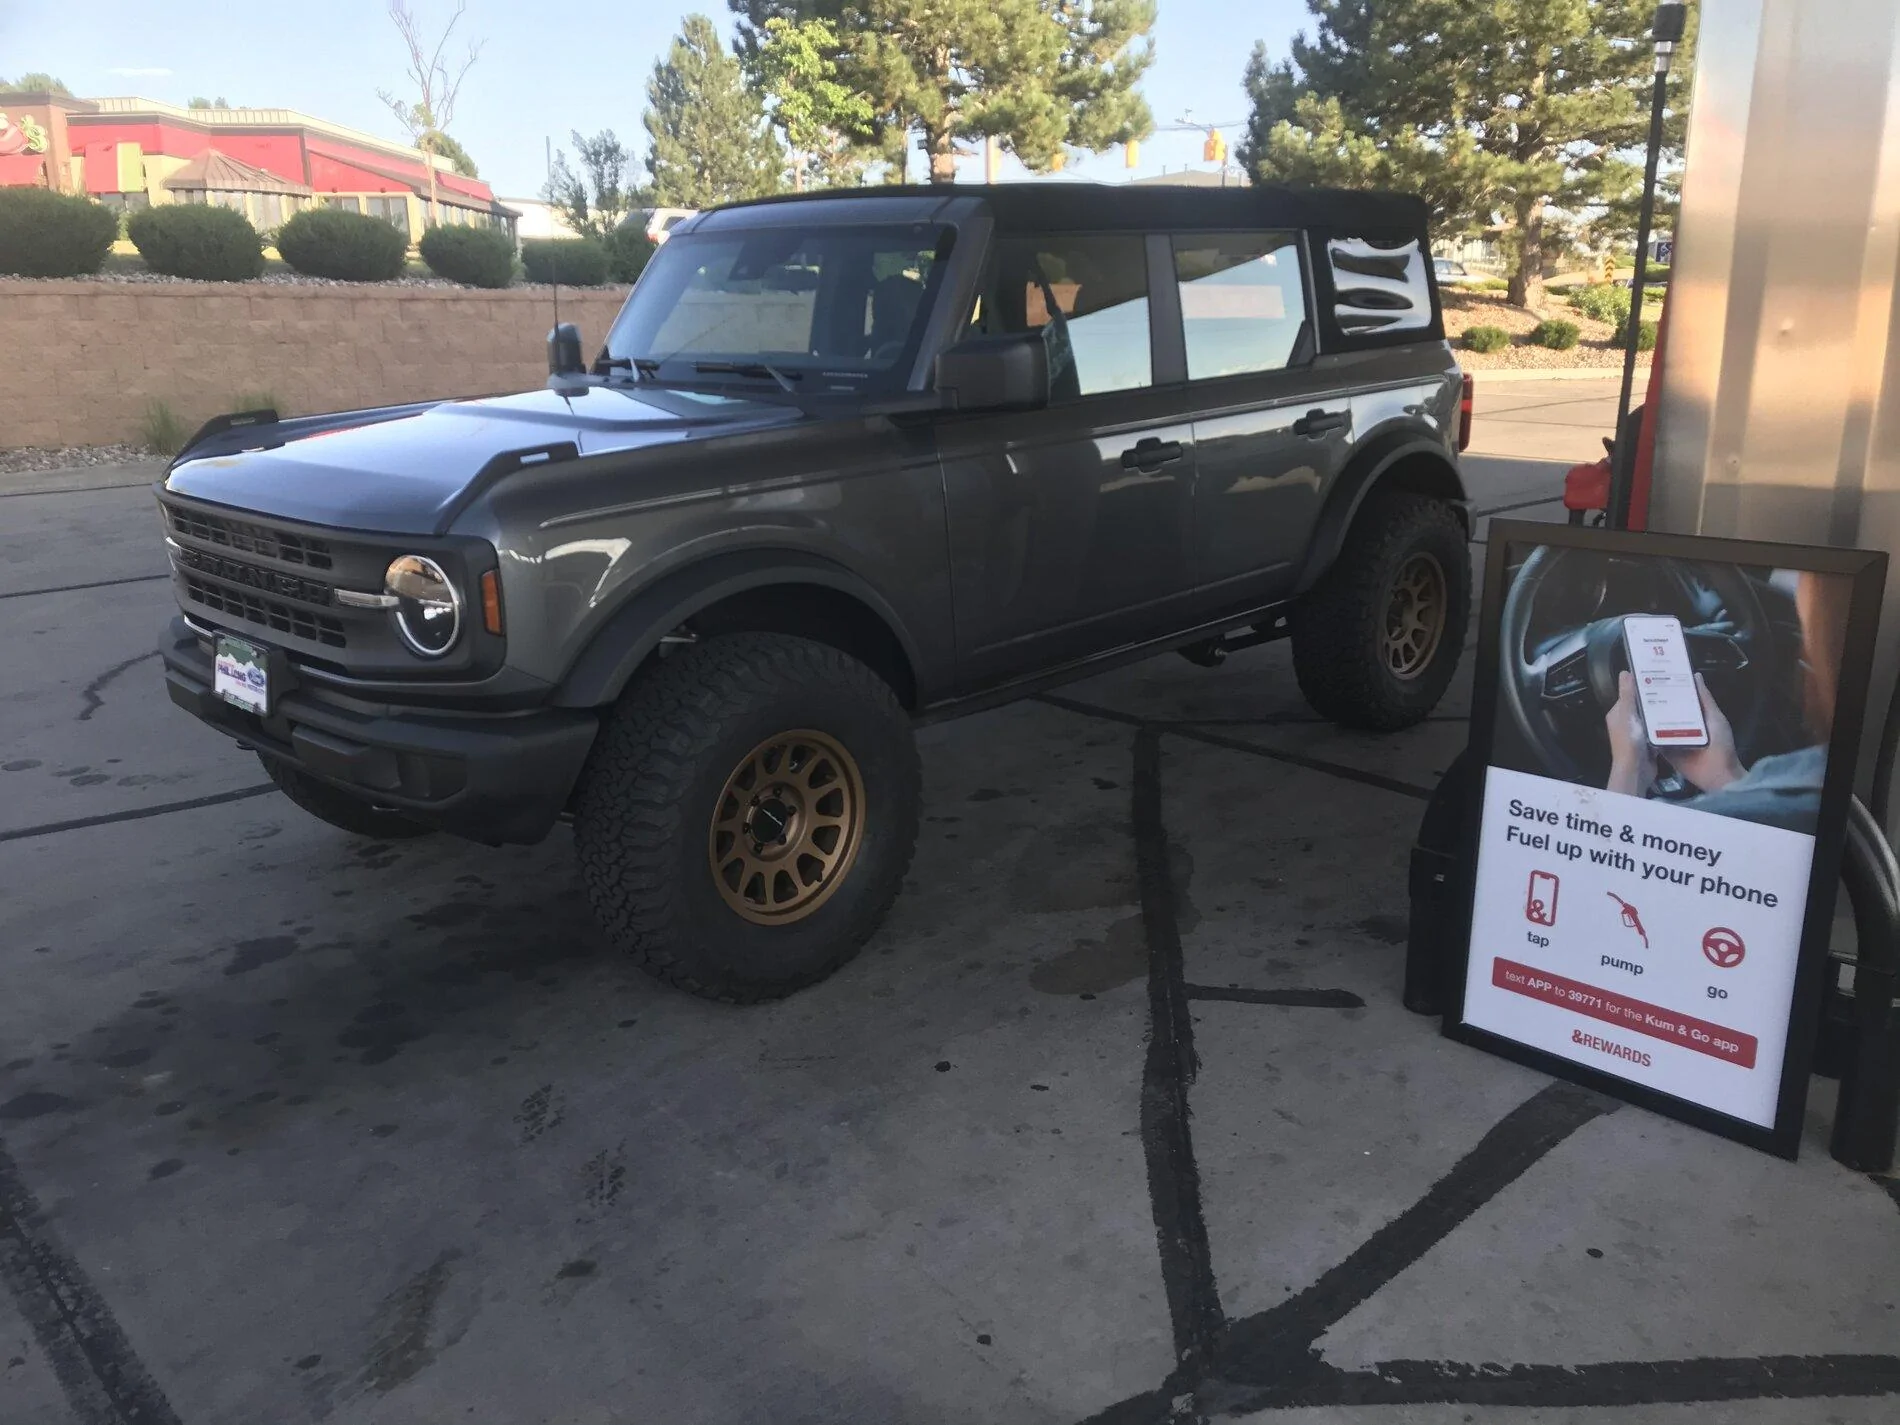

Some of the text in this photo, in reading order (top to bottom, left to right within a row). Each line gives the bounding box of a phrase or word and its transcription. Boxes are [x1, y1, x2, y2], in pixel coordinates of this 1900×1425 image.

[1509, 799, 1722, 867] Save time & money
[1506, 825, 1778, 908] Fuel up with your phone
[1527, 931, 1549, 948] tap
[1600, 954, 1644, 976] pump
[1707, 985, 1728, 999] go
[1505, 970, 1740, 1053] text APP to 39771 for the Kum & Go app
[1571, 1029, 1651, 1067] &REWARDS
